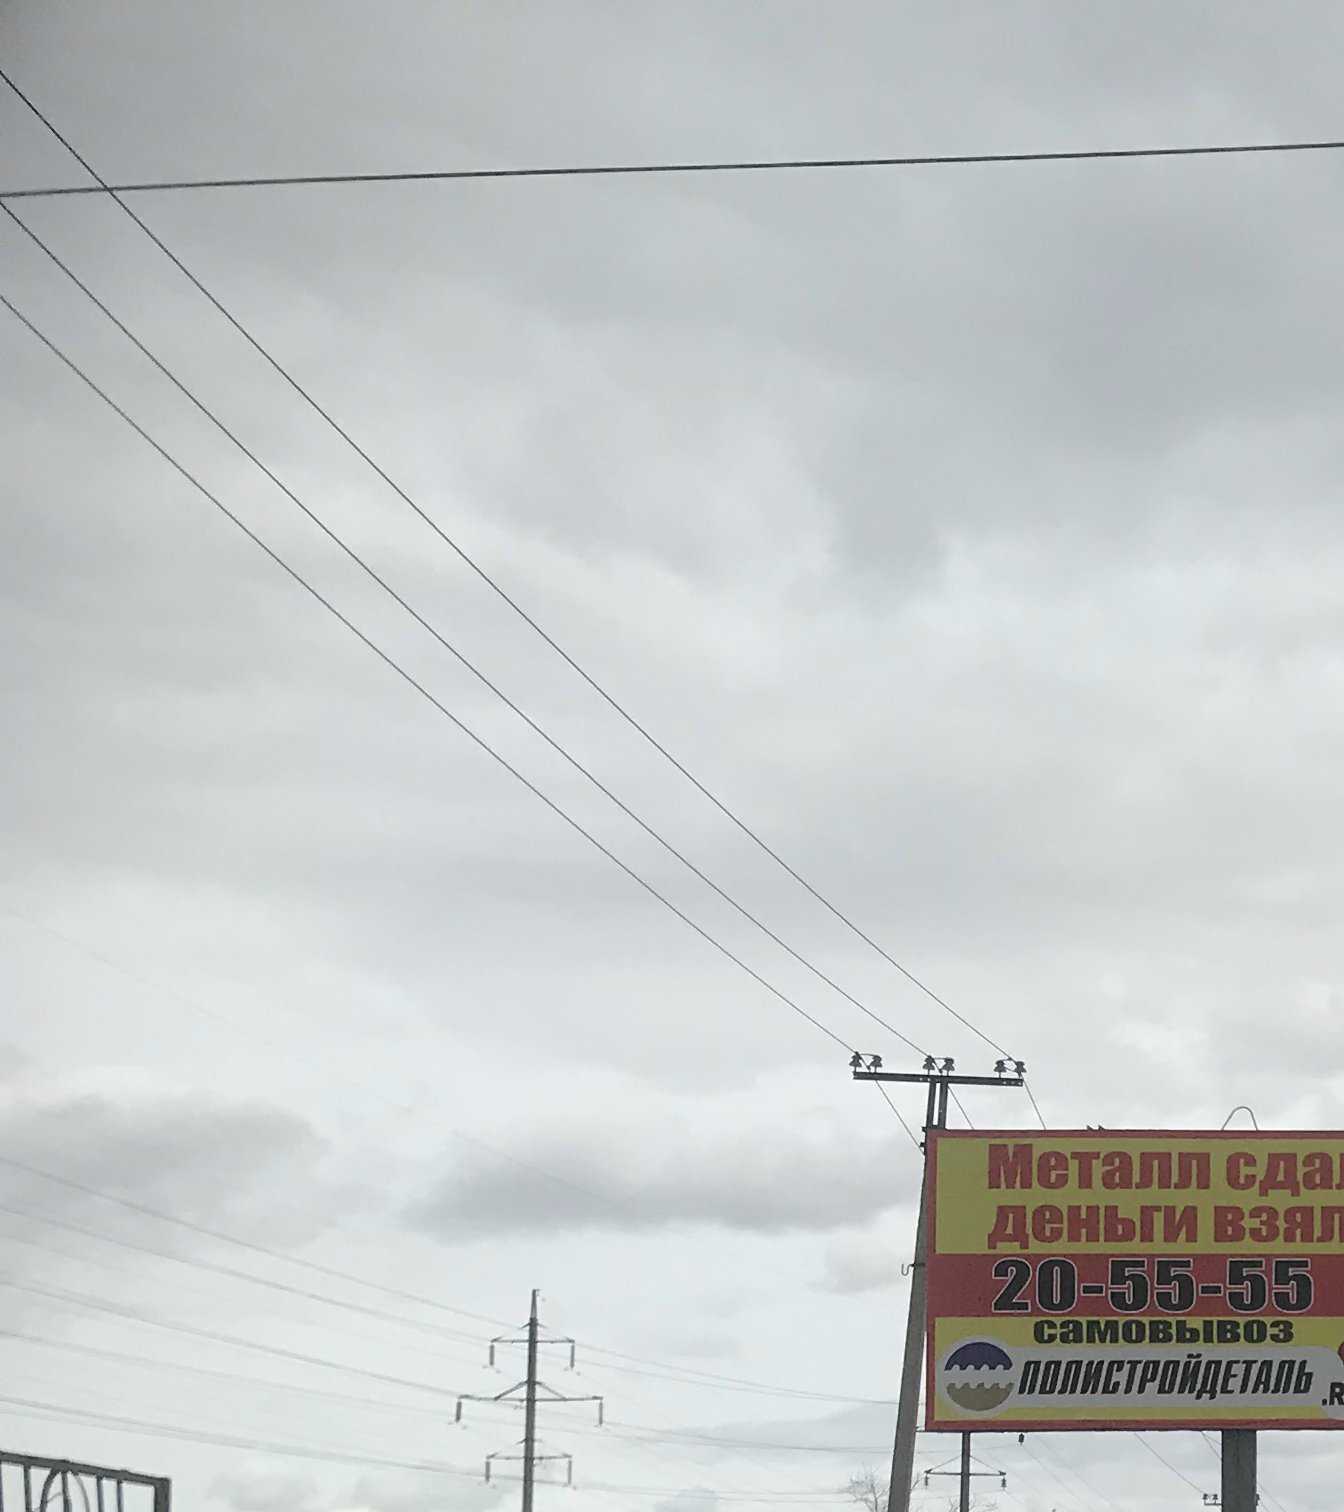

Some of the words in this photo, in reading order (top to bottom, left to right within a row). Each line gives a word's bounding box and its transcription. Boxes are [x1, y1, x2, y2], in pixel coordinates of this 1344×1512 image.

[987, 1143, 1211, 1190] Металл
[987, 1204, 1198, 1249] деньги
[992, 1257, 1313, 1314] 20-55-55
[1033, 1318, 1294, 1344] самовывоз
[1018, 1354, 1312, 1399] ПОЛИСТРОЙДЕТАЛЬ
